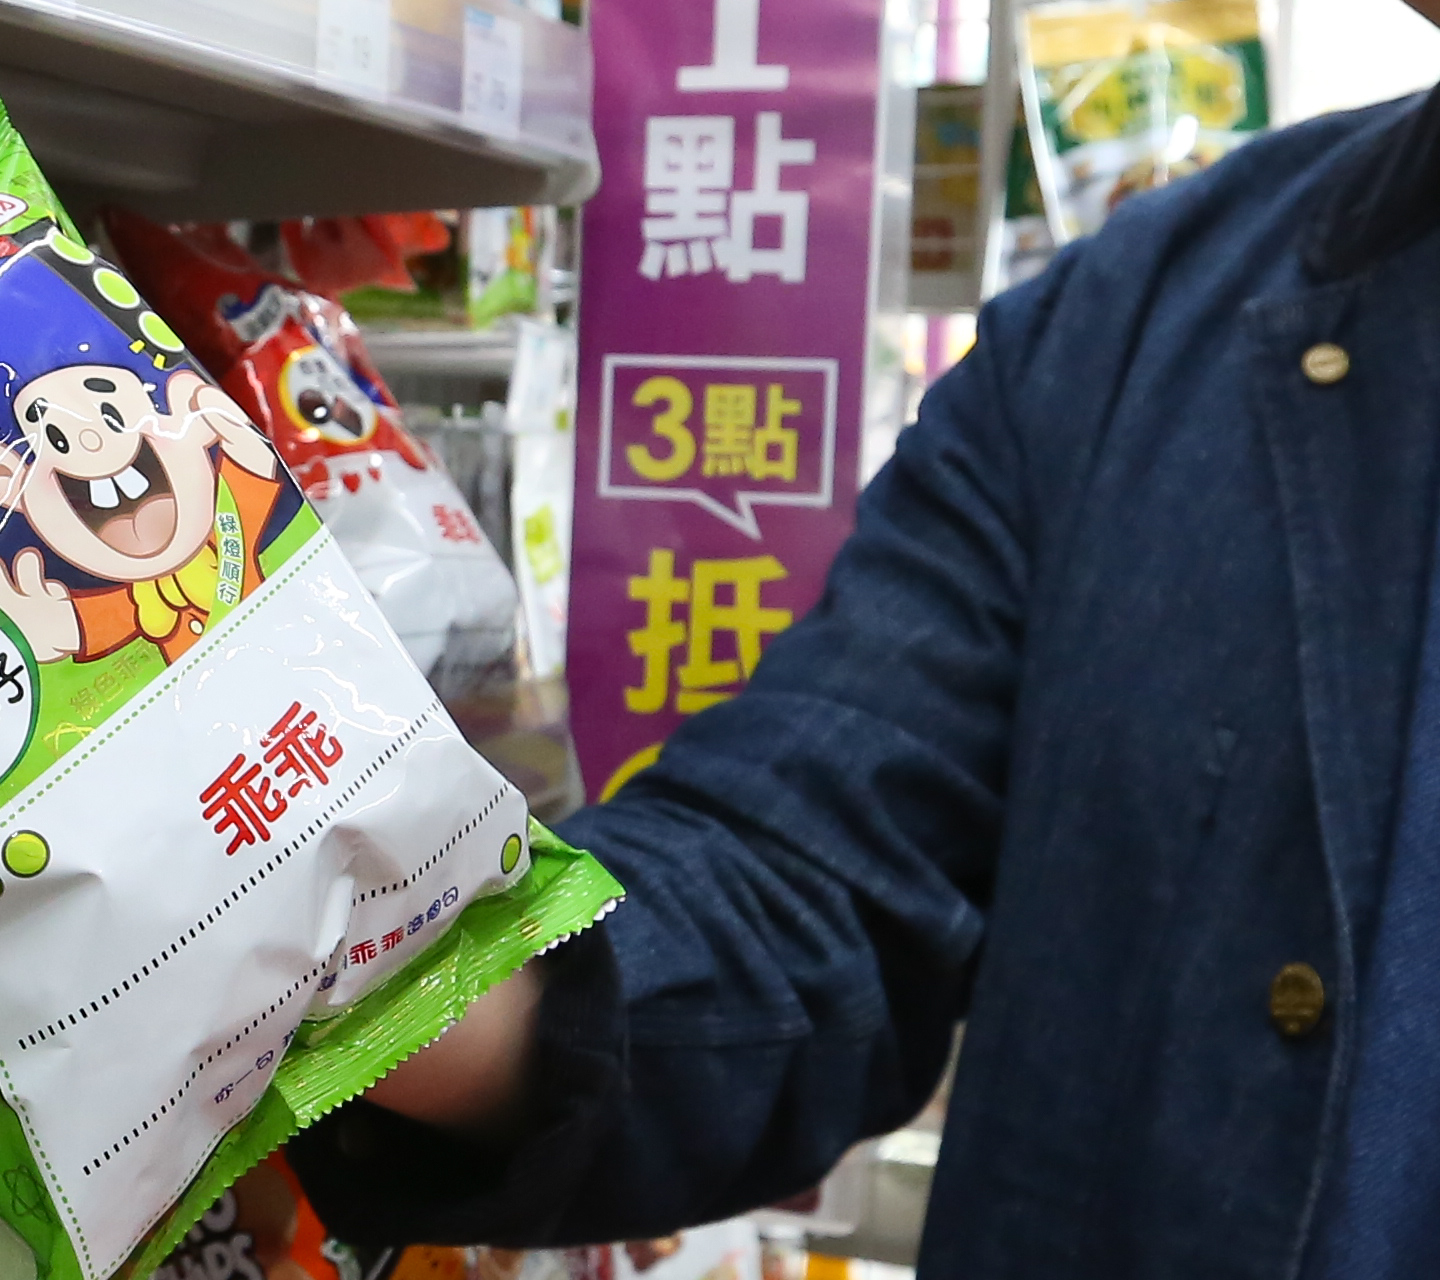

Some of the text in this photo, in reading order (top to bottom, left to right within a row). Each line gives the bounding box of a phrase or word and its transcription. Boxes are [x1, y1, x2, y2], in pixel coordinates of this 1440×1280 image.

[625, 373, 803, 486] 3點
[217, 510, 245, 608] 綠燈順行
[197, 699, 345, 858] 乖乖
